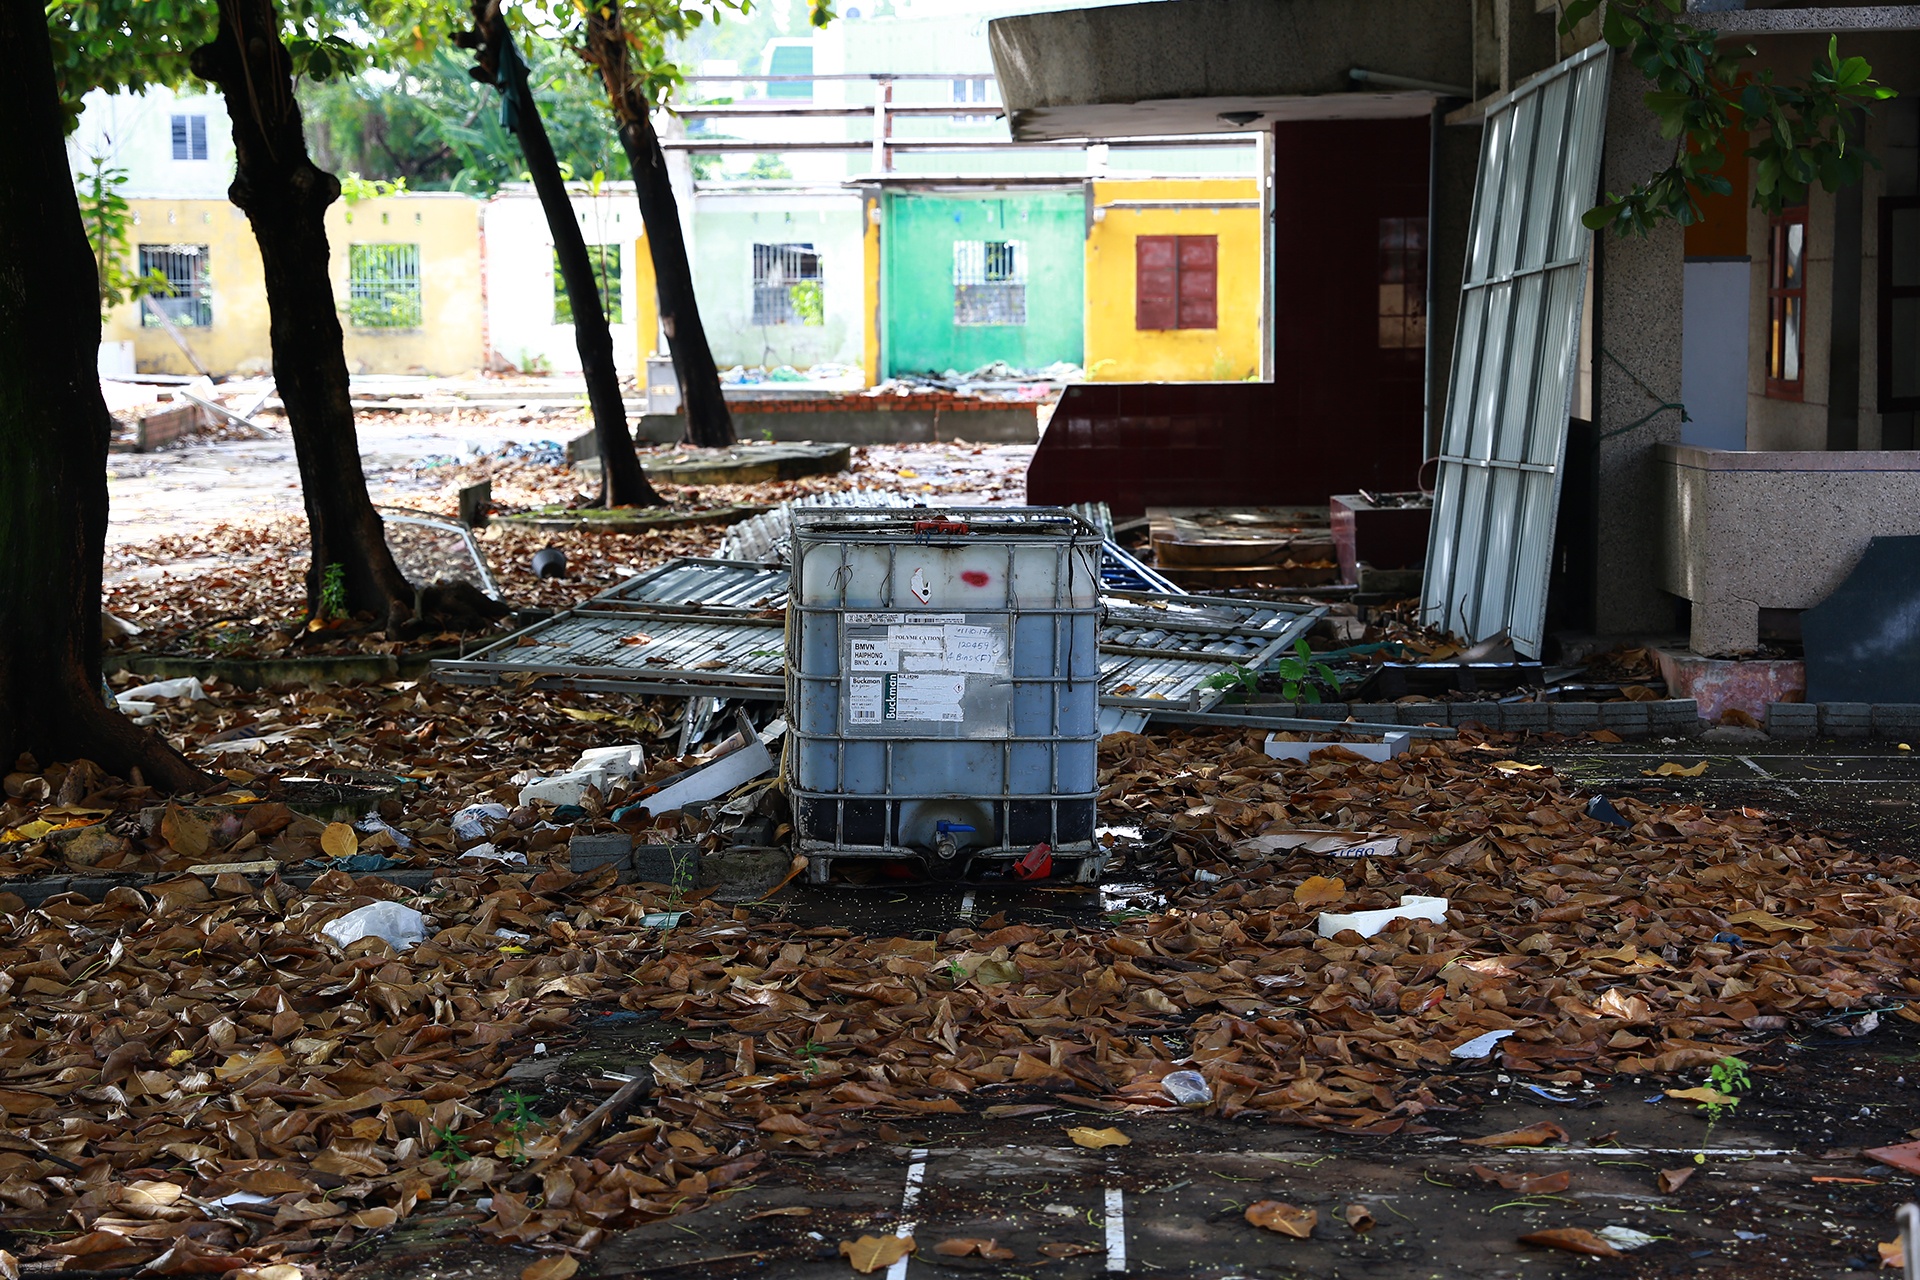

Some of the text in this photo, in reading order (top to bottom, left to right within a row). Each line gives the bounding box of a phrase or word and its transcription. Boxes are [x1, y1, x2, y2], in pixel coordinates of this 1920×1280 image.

[957, 641, 989, 650] 120459
[956, 653, 973, 661] Bins
[886, 674, 897, 719] Buckman
